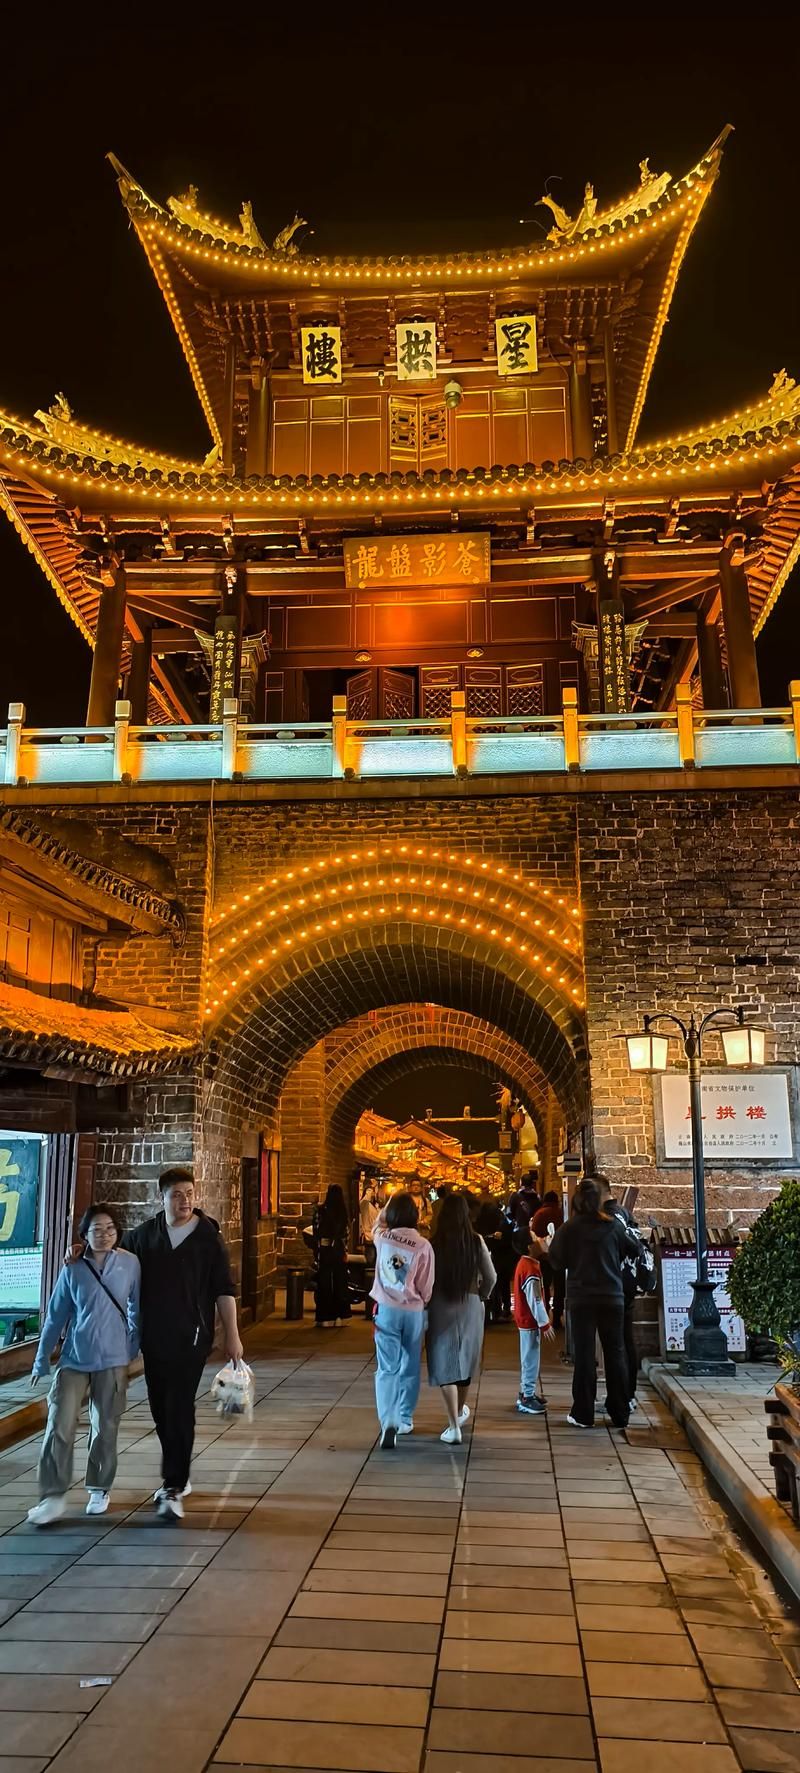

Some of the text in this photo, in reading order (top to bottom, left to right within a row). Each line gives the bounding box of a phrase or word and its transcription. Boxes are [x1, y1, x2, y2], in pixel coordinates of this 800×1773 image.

[305, 331, 339, 379] 樓
[399, 329, 434, 374] 拱
[500, 321, 532, 370] 星
